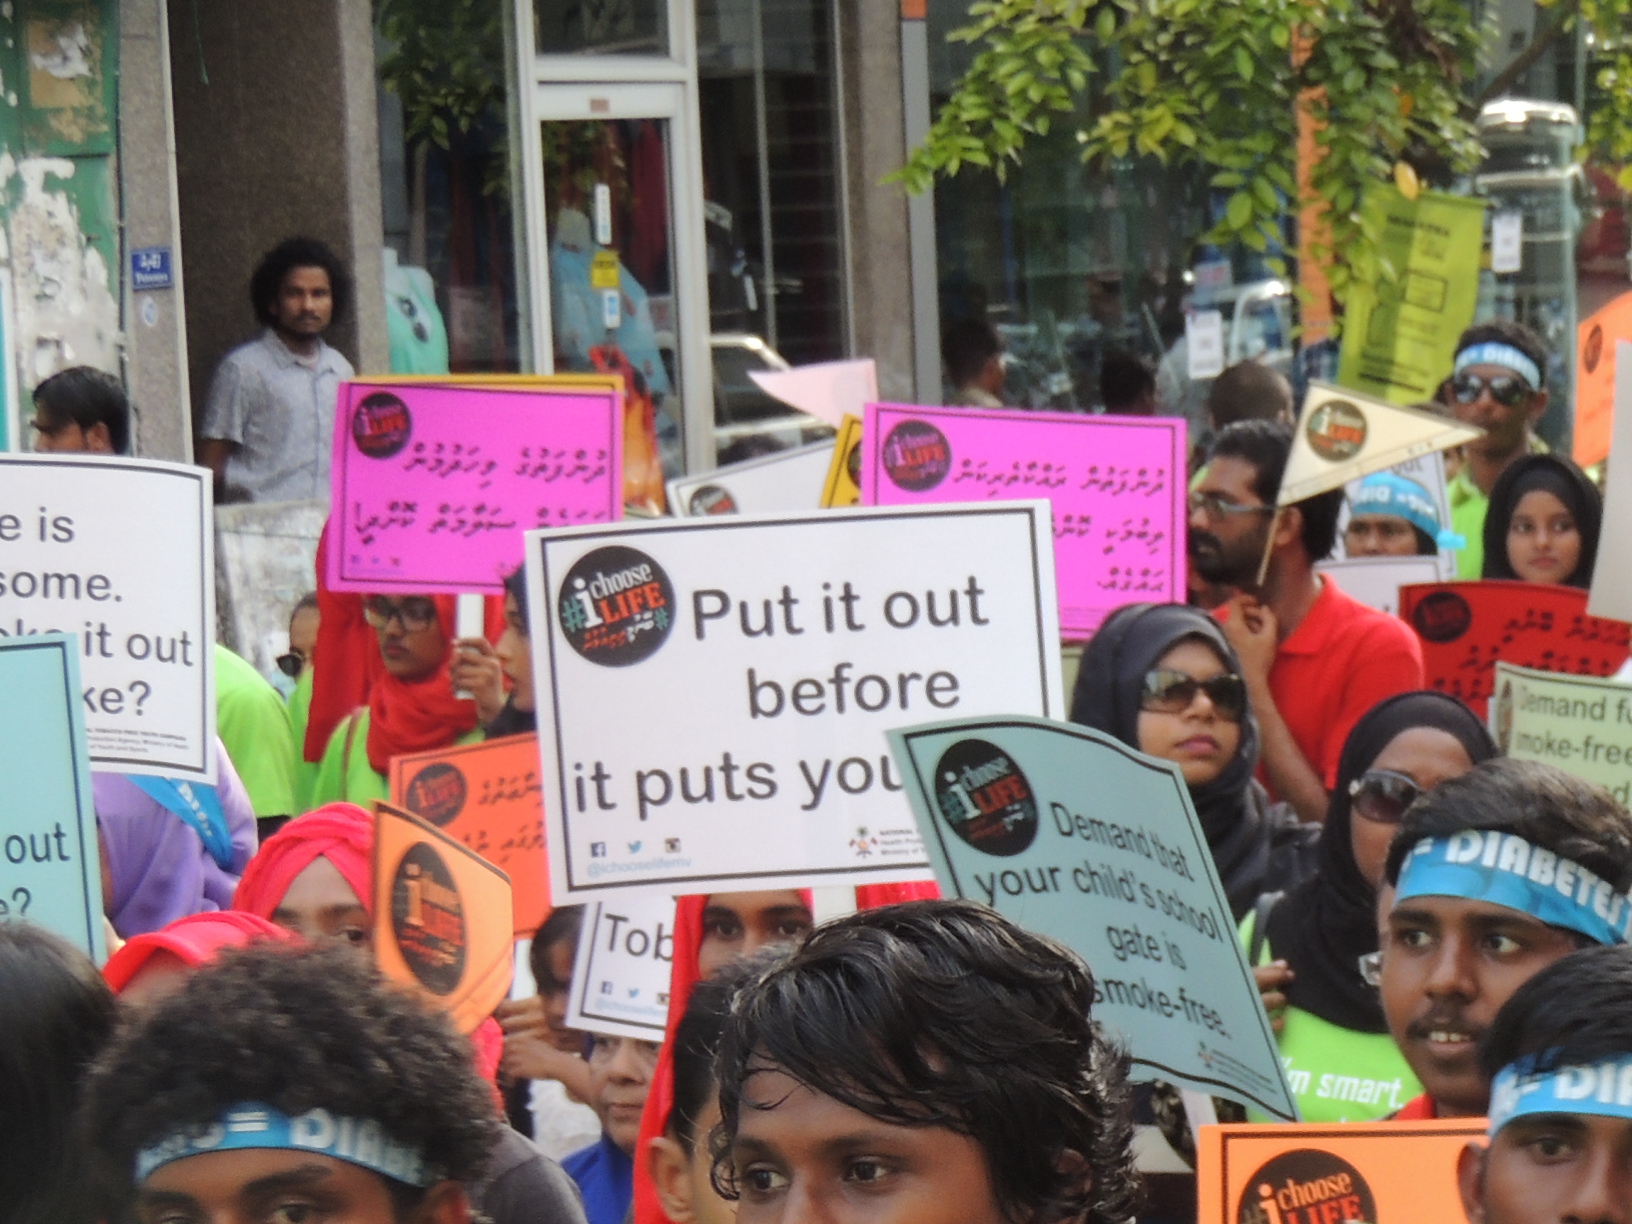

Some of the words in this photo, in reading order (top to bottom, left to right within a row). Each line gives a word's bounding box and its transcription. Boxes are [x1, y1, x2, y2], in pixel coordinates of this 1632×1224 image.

[39, 506, 75, 543] is
[590, 563, 653, 600] choose
[599, 582, 666, 625] LIFE
[692, 584, 805, 641] Put
[822, 581, 865, 634] it
[884, 576, 990, 631] out
[85, 621, 113, 658] it
[127, 631, 193, 667] out
[747, 662, 961, 720] before
[572, 762, 617, 813] it
[636, 751, 778, 822] puts
[5, 822, 70, 864] out
[1050, 801, 1152, 857] Demand
[1155, 833, 1196, 883] that
[975, 863, 1061, 906] your
[1073, 861, 1154, 911] child's
[1156, 889, 1224, 944] school
[1107, 924, 1163, 962] gate
[1165, 934, 1188, 971] is
[1317, 1076, 1404, 1110] smart.
[1278, 1172, 1353, 1211] choose
